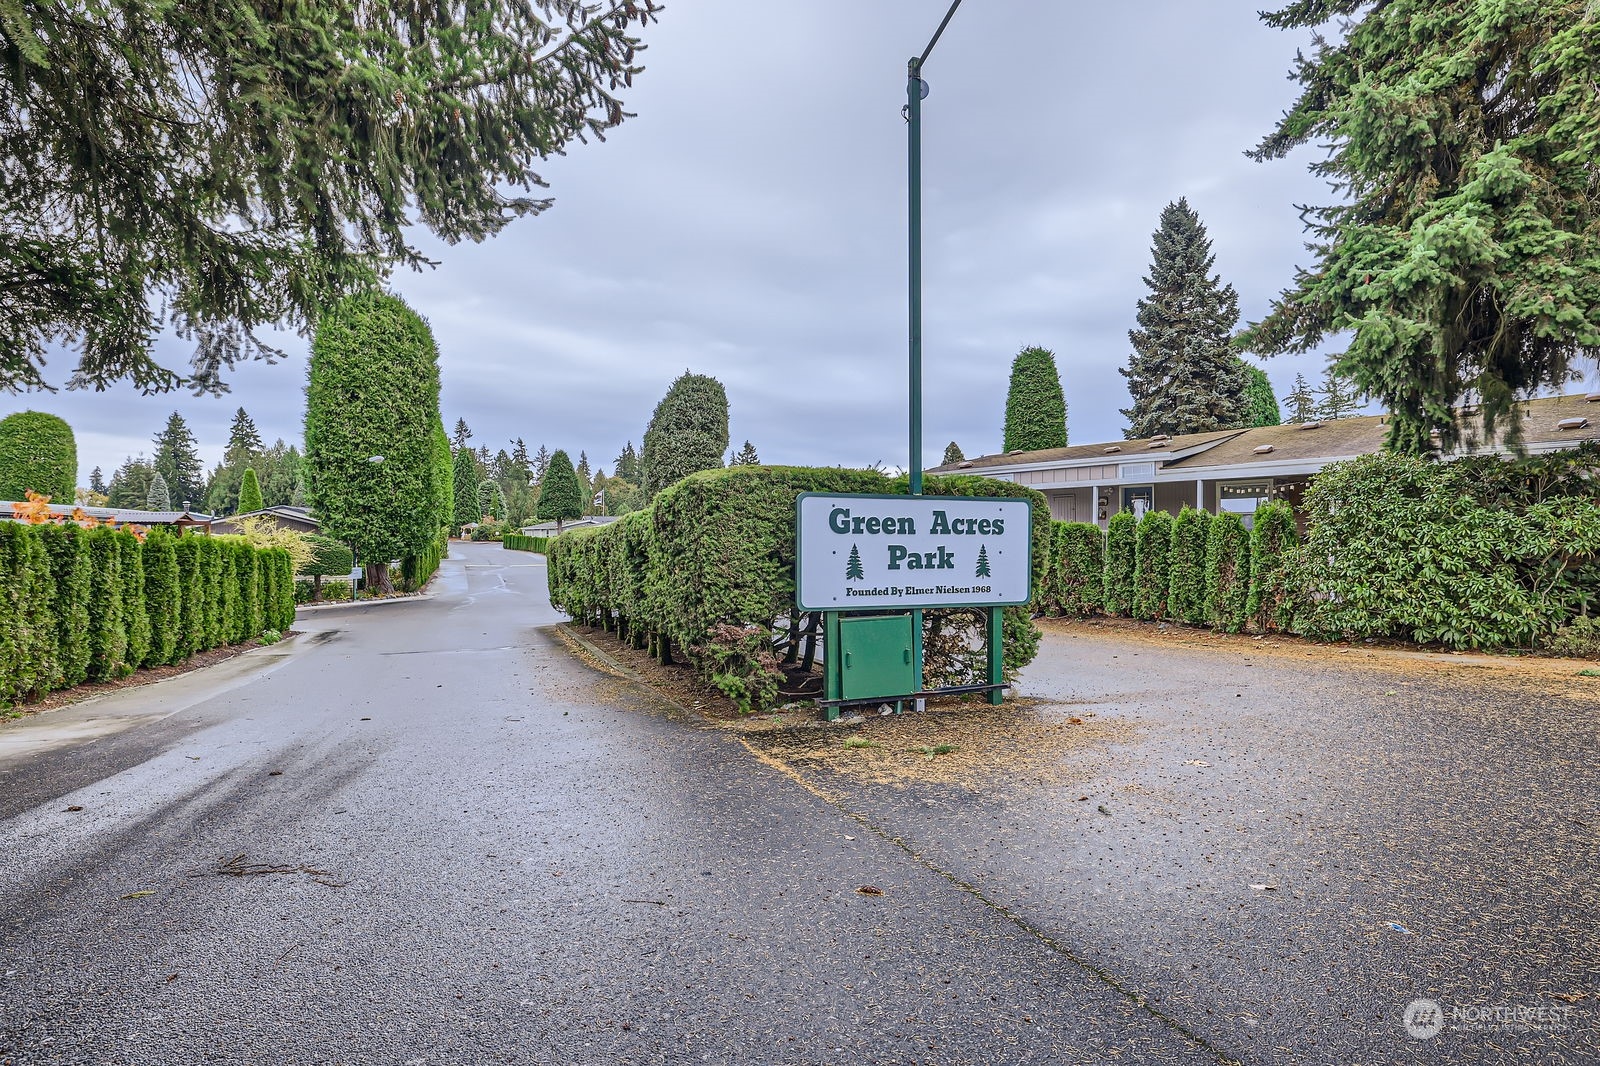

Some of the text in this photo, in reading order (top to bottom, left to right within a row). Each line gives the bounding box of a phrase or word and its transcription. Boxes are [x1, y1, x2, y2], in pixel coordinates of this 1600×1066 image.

[828, 507, 1005, 536] Green Acres
[887, 544, 955, 570] Park
[846, 585, 992, 598] Founded By Elmer Nielsen 1968
